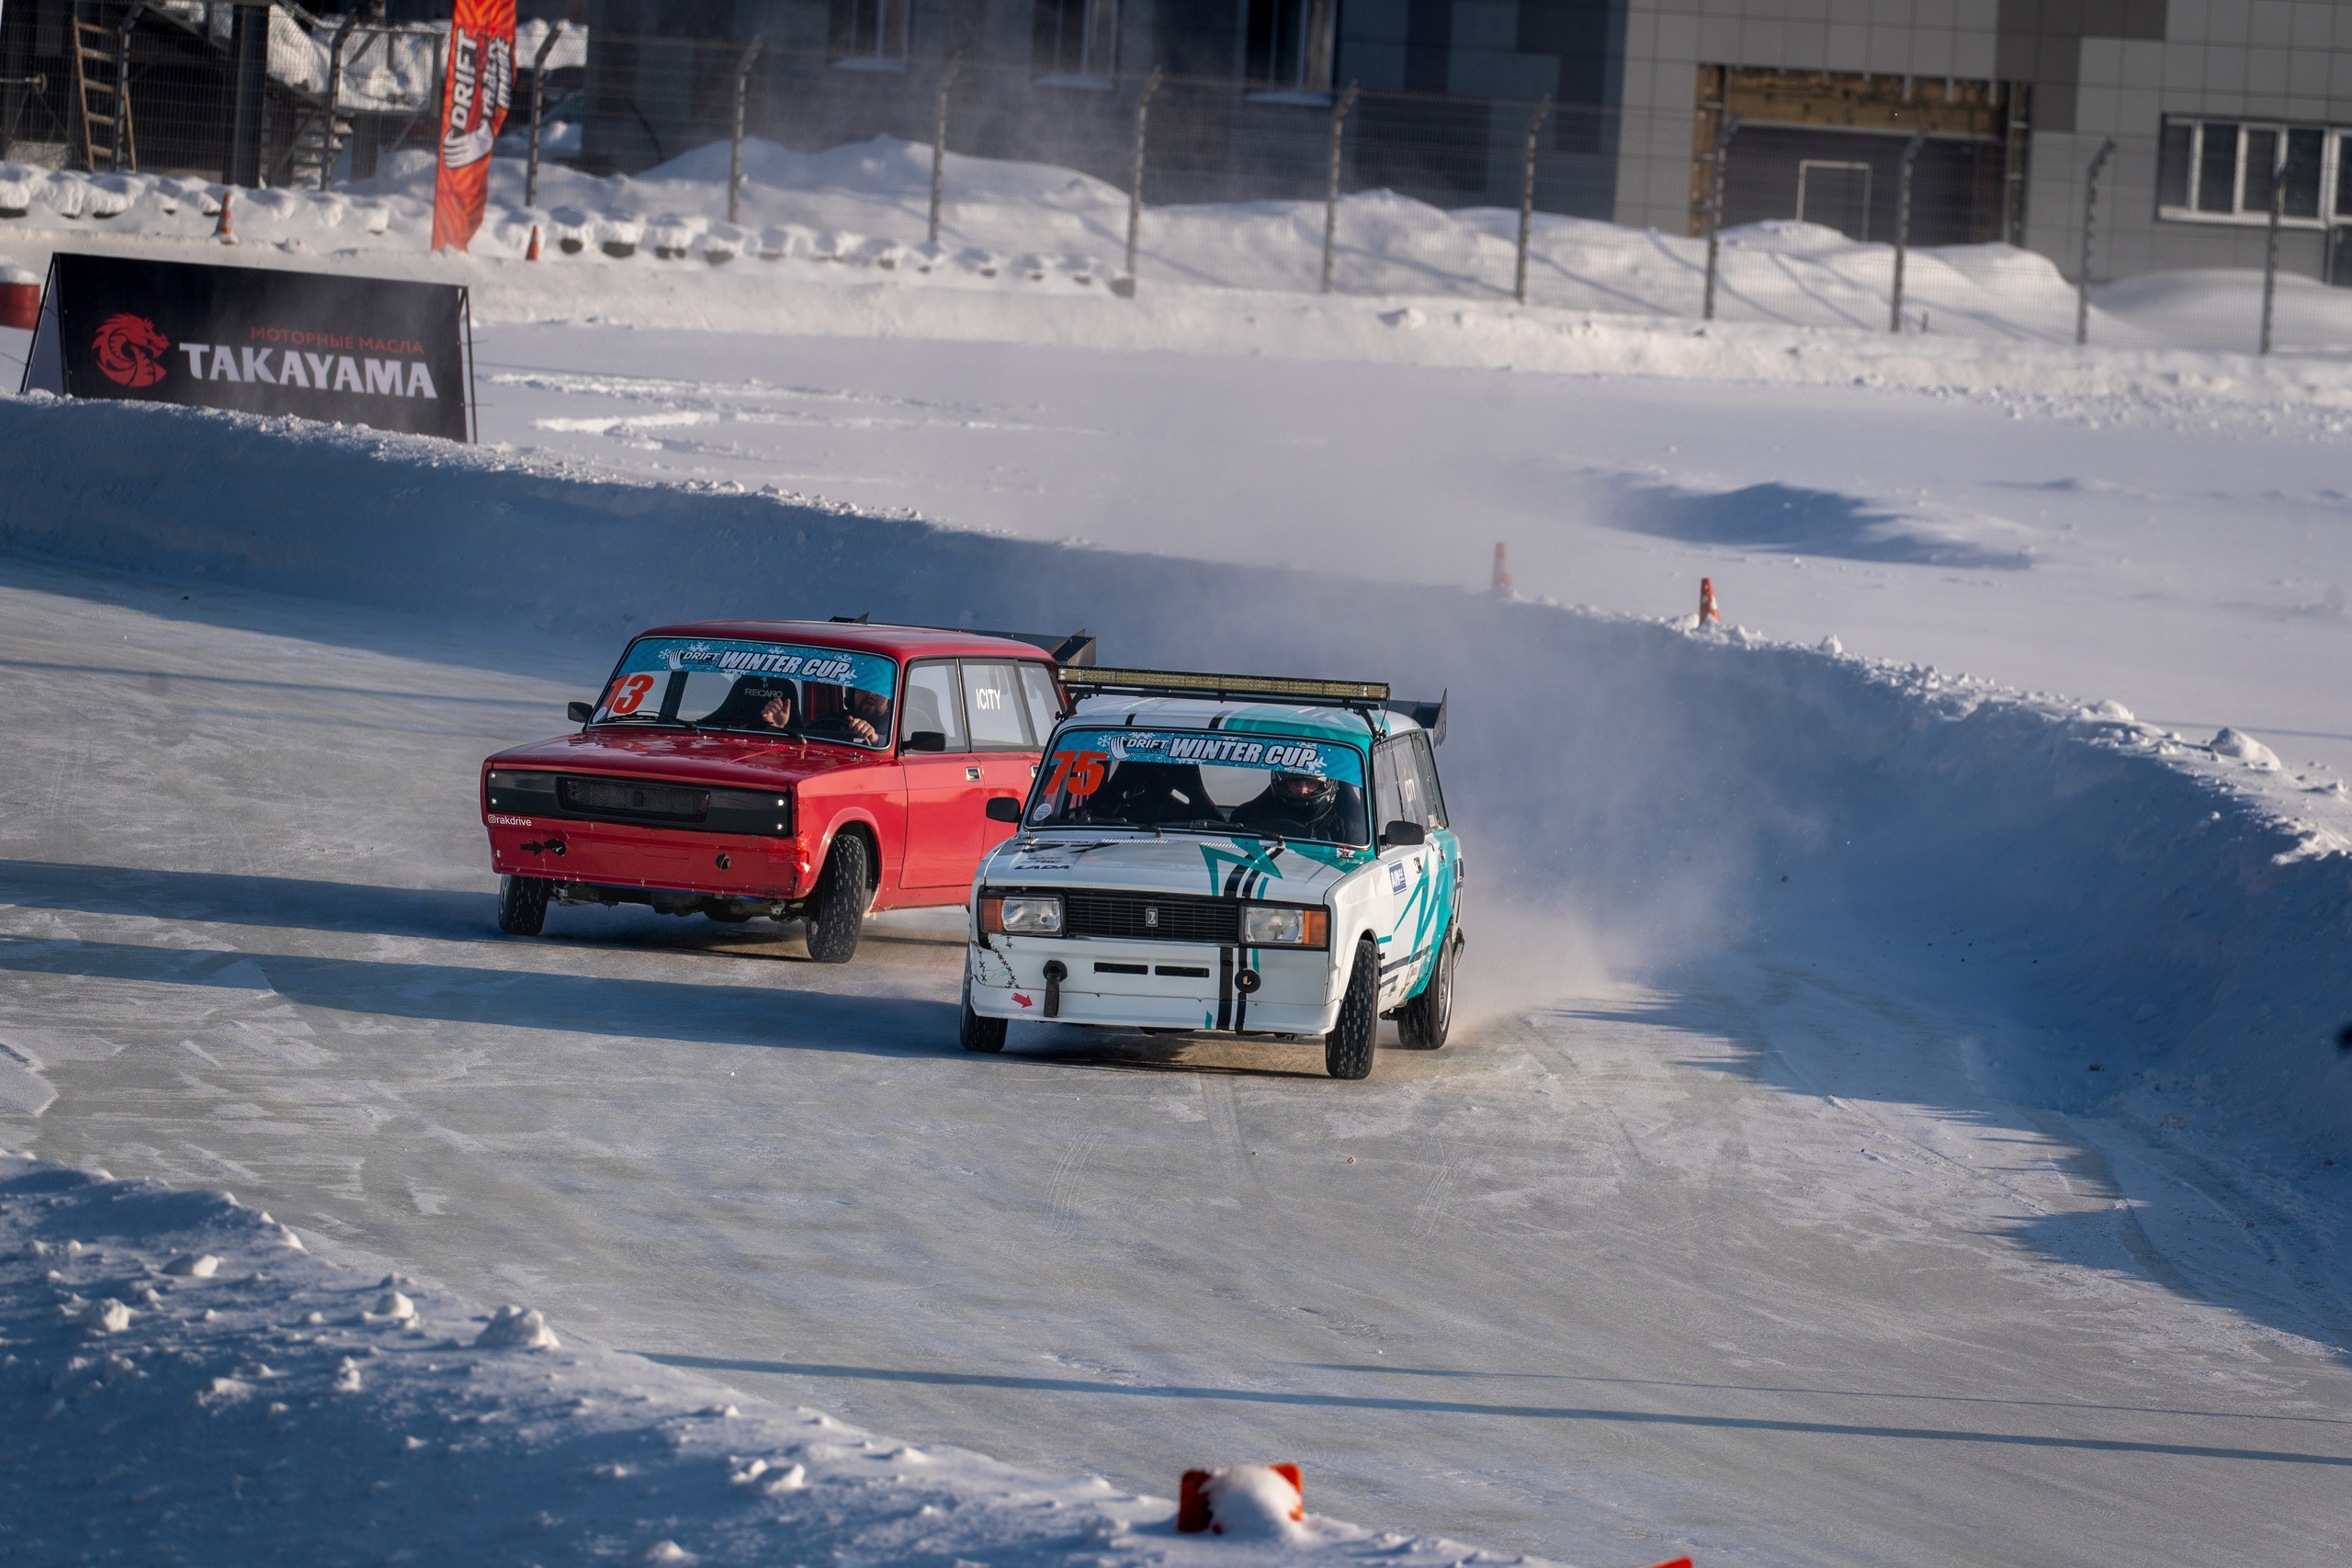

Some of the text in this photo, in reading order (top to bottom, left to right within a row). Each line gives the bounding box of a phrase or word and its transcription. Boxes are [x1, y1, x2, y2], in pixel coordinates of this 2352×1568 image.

[452, 27, 477, 130] DRIFT
[250, 326, 424, 355] МОТОРНЫЕ МАСЛА
[179, 342, 438, 399] TAKAYAMA
[683, 650, 853, 679] DRIFT WINTER CUP
[603, 673, 655, 714] 13
[744, 687, 783, 698] RECARO
[976, 688, 1001, 710] ICITY
[1126, 737, 1317, 768] DRIFT WINTER CUP
[1043, 750, 1109, 795] 75
